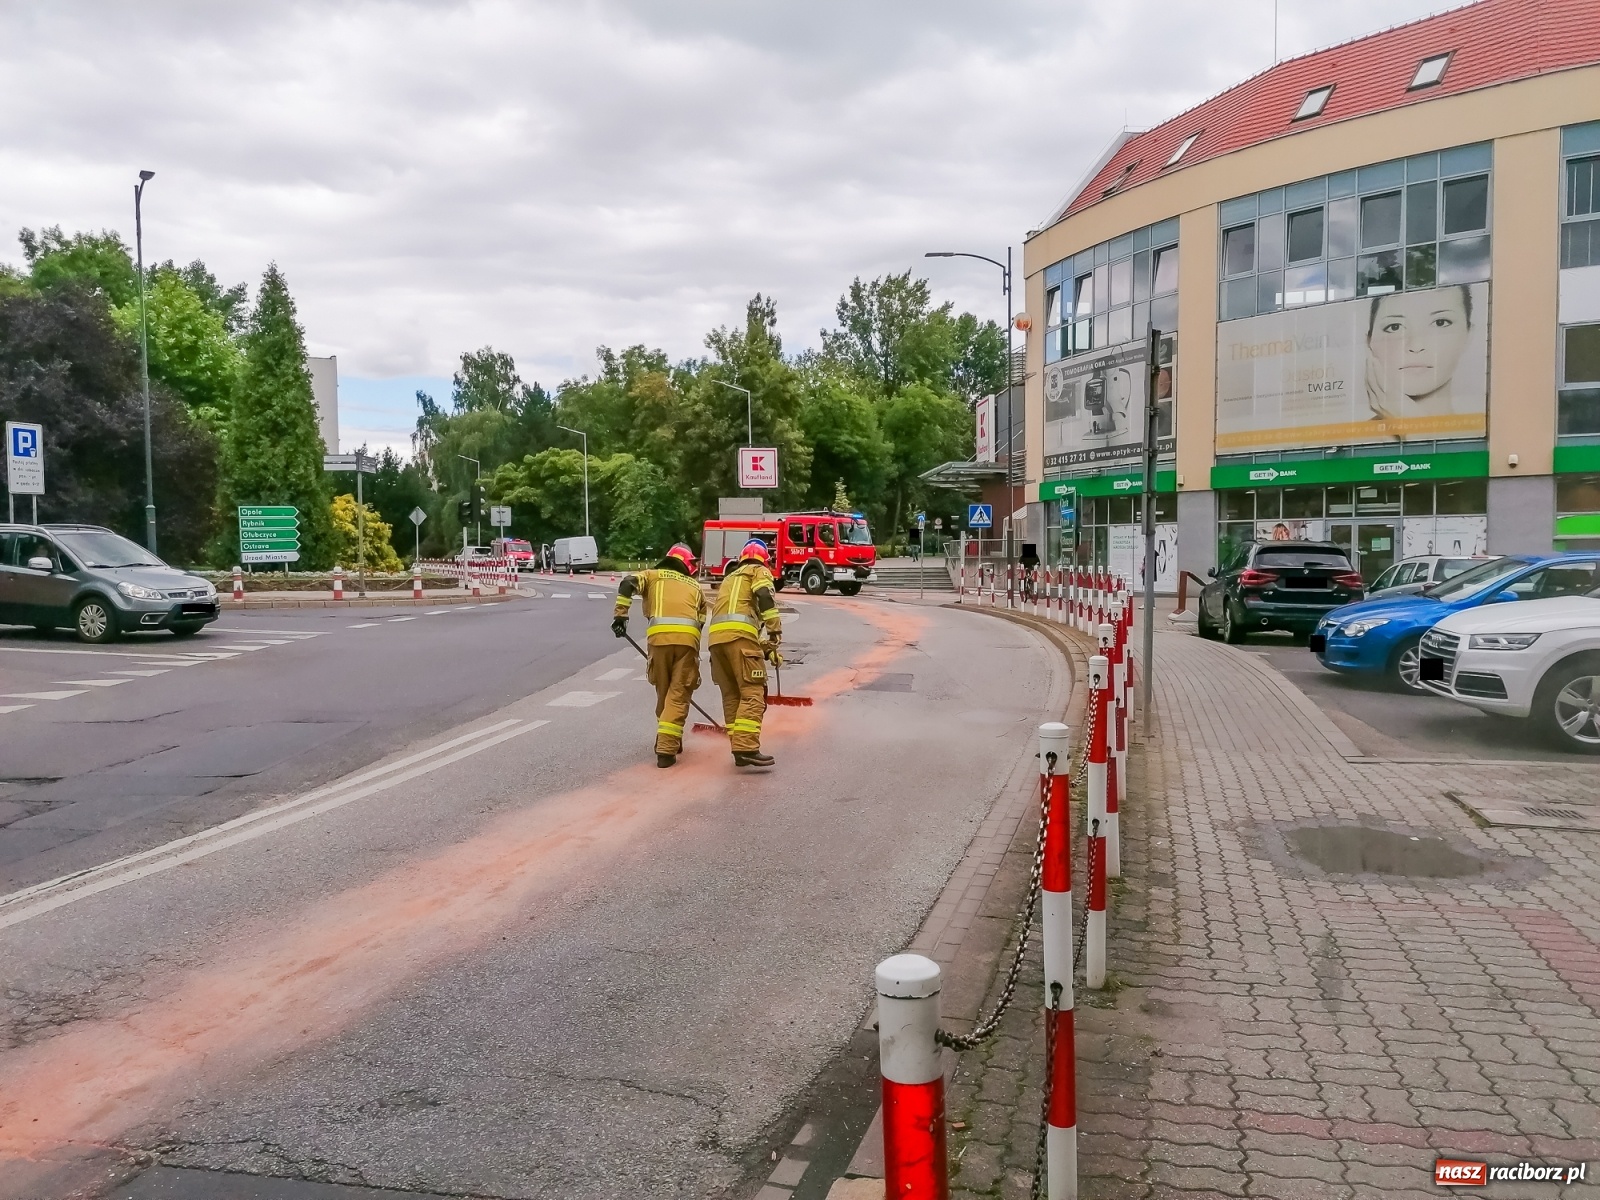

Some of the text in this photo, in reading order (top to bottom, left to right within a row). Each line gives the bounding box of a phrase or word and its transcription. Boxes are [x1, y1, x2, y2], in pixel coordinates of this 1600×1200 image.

[1094, 360, 1106, 369] OKA
[1308, 381, 1344, 393] twarz
[1050, 457, 1057, 465] 32
[1058, 455, 1068, 464] 415
[1069, 454, 1077, 462] 27
[1078, 453, 1086, 461] 21
[241, 509, 263, 517] Opole
[242, 520, 265, 528] Rybnik
